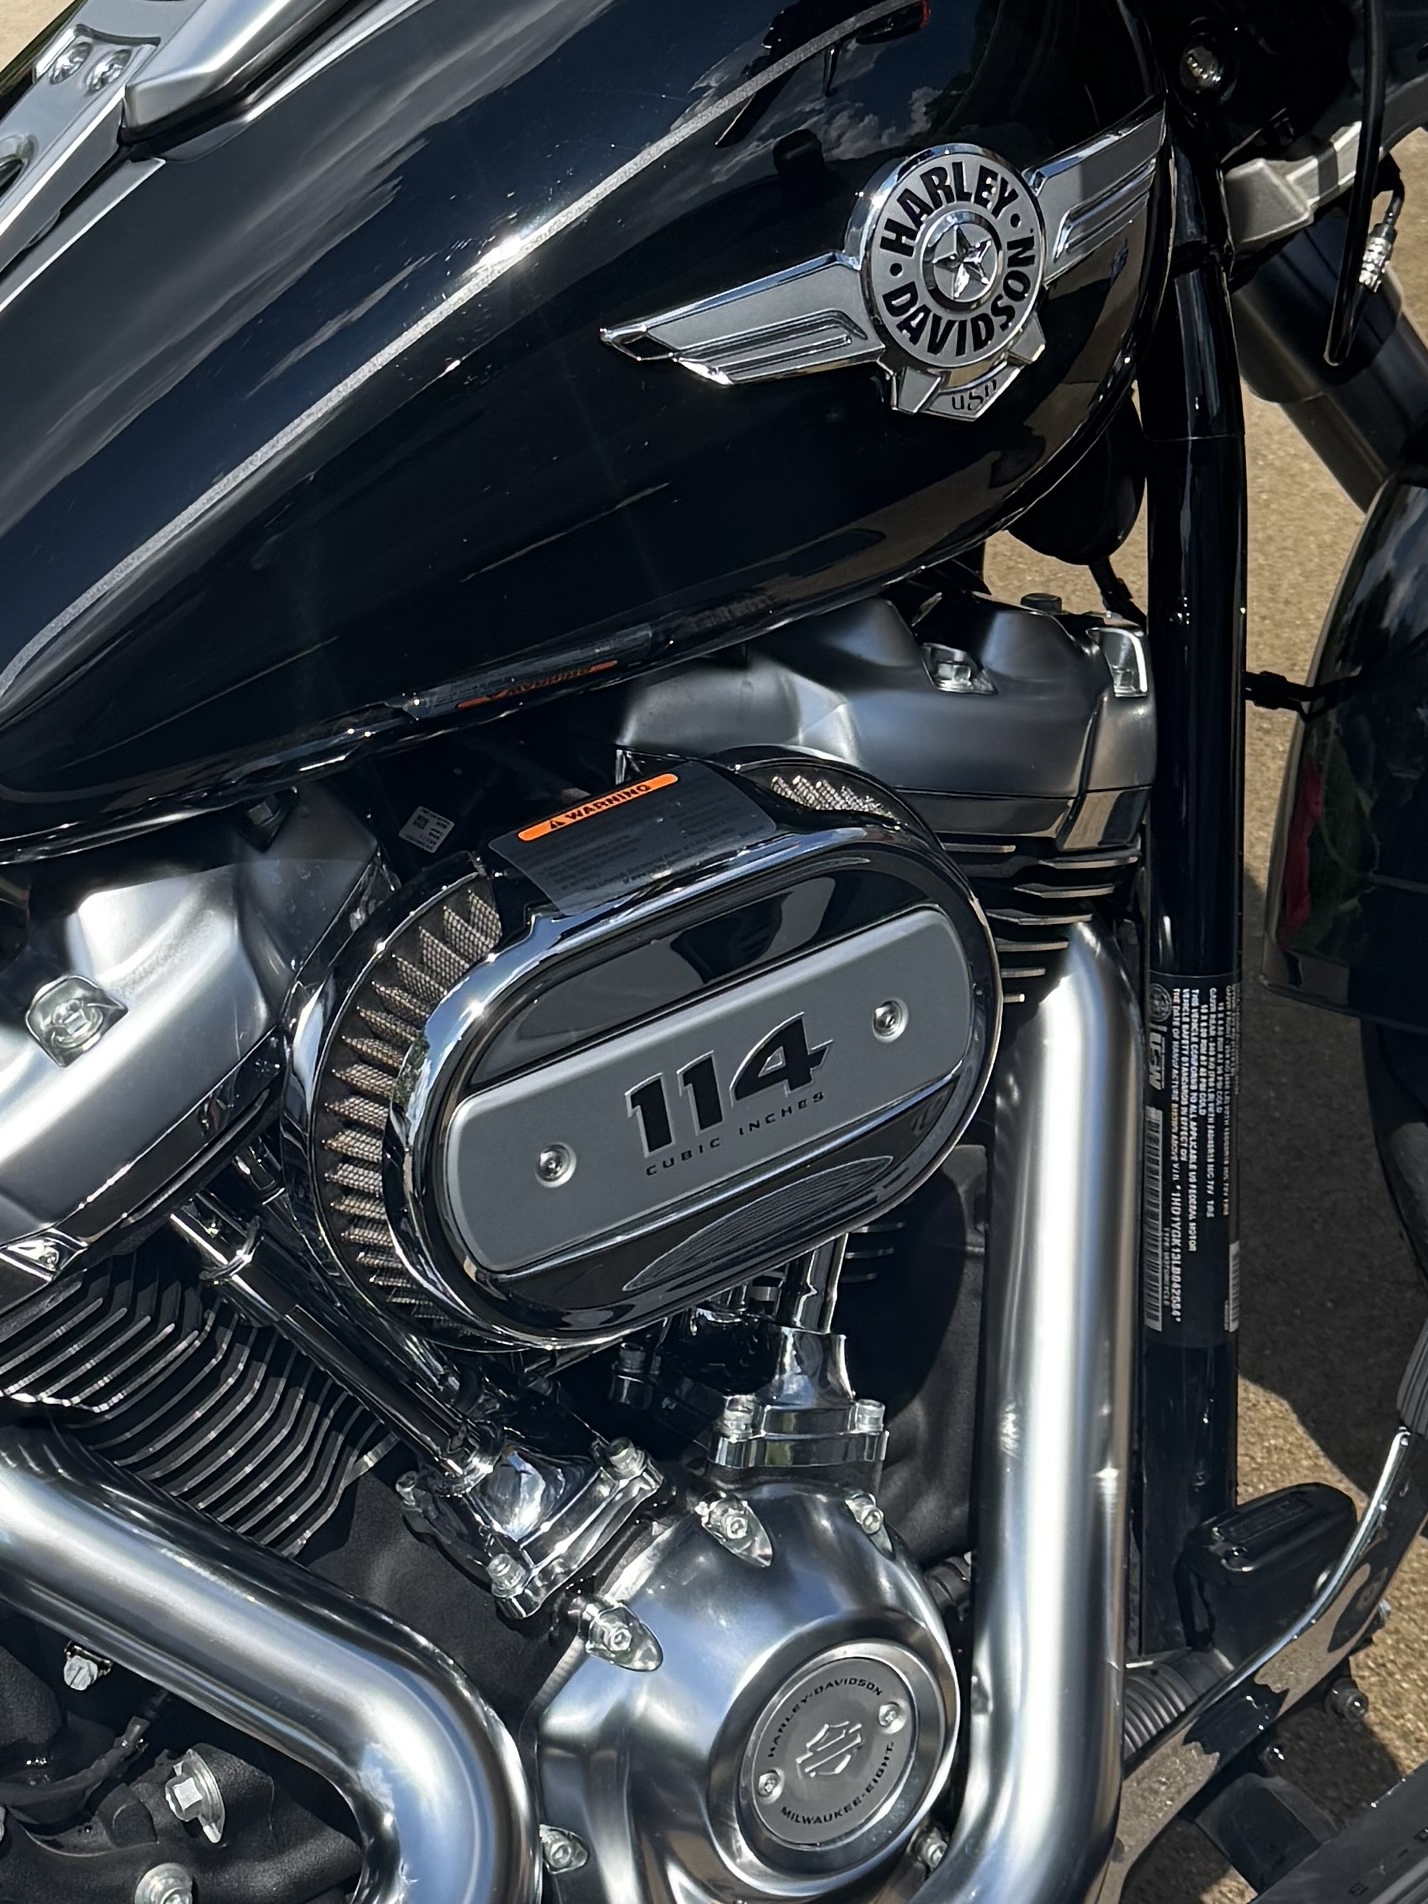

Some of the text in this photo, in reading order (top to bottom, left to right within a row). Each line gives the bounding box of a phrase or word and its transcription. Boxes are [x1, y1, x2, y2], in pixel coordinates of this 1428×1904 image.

[879, 161, 1020, 258] HARLEY
[882, 234, 1036, 358] DAVIDSON
[565, 783, 651, 821] WARNING
[1191, 1009, 1199, 1042] VEHICLE
[623, 1011, 834, 1158] 114
[645, 1091, 827, 1176] CUBIC INCHES
[1180, 1117, 1188, 1147] EFFECT
[767, 1675, 884, 1758] HARLEY-DAVIDSON
